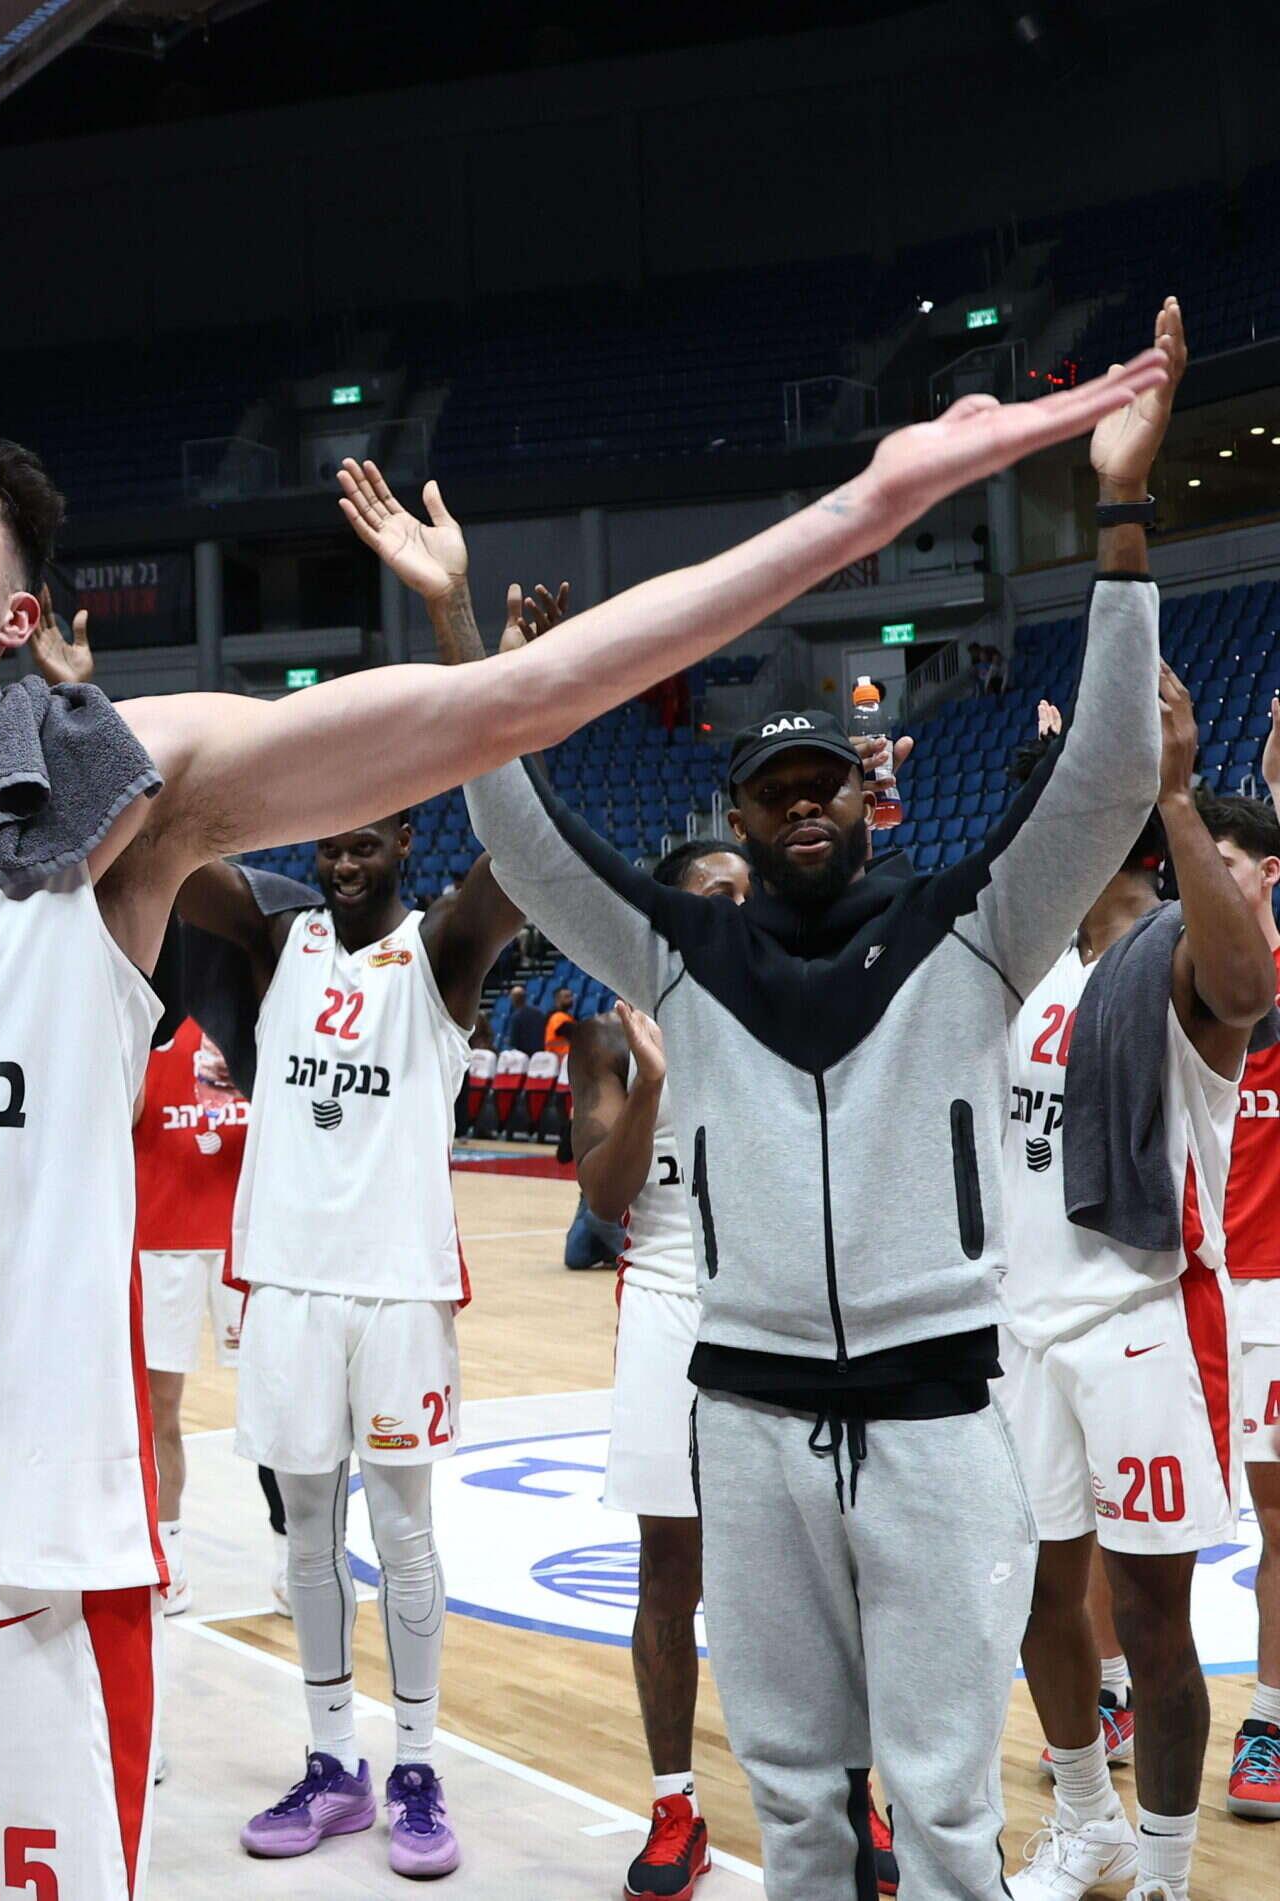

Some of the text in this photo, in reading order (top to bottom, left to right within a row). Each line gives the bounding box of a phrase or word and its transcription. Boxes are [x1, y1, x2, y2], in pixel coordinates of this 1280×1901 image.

[314, 987, 365, 1040] 22
[285, 1055, 390, 1098] בנק יהב
[162, 1104, 204, 1131] יהב
[1239, 1089, 1280, 1119] בנ
[423, 1385, 454, 1447] 2
[1117, 1455, 1186, 1523] 20
